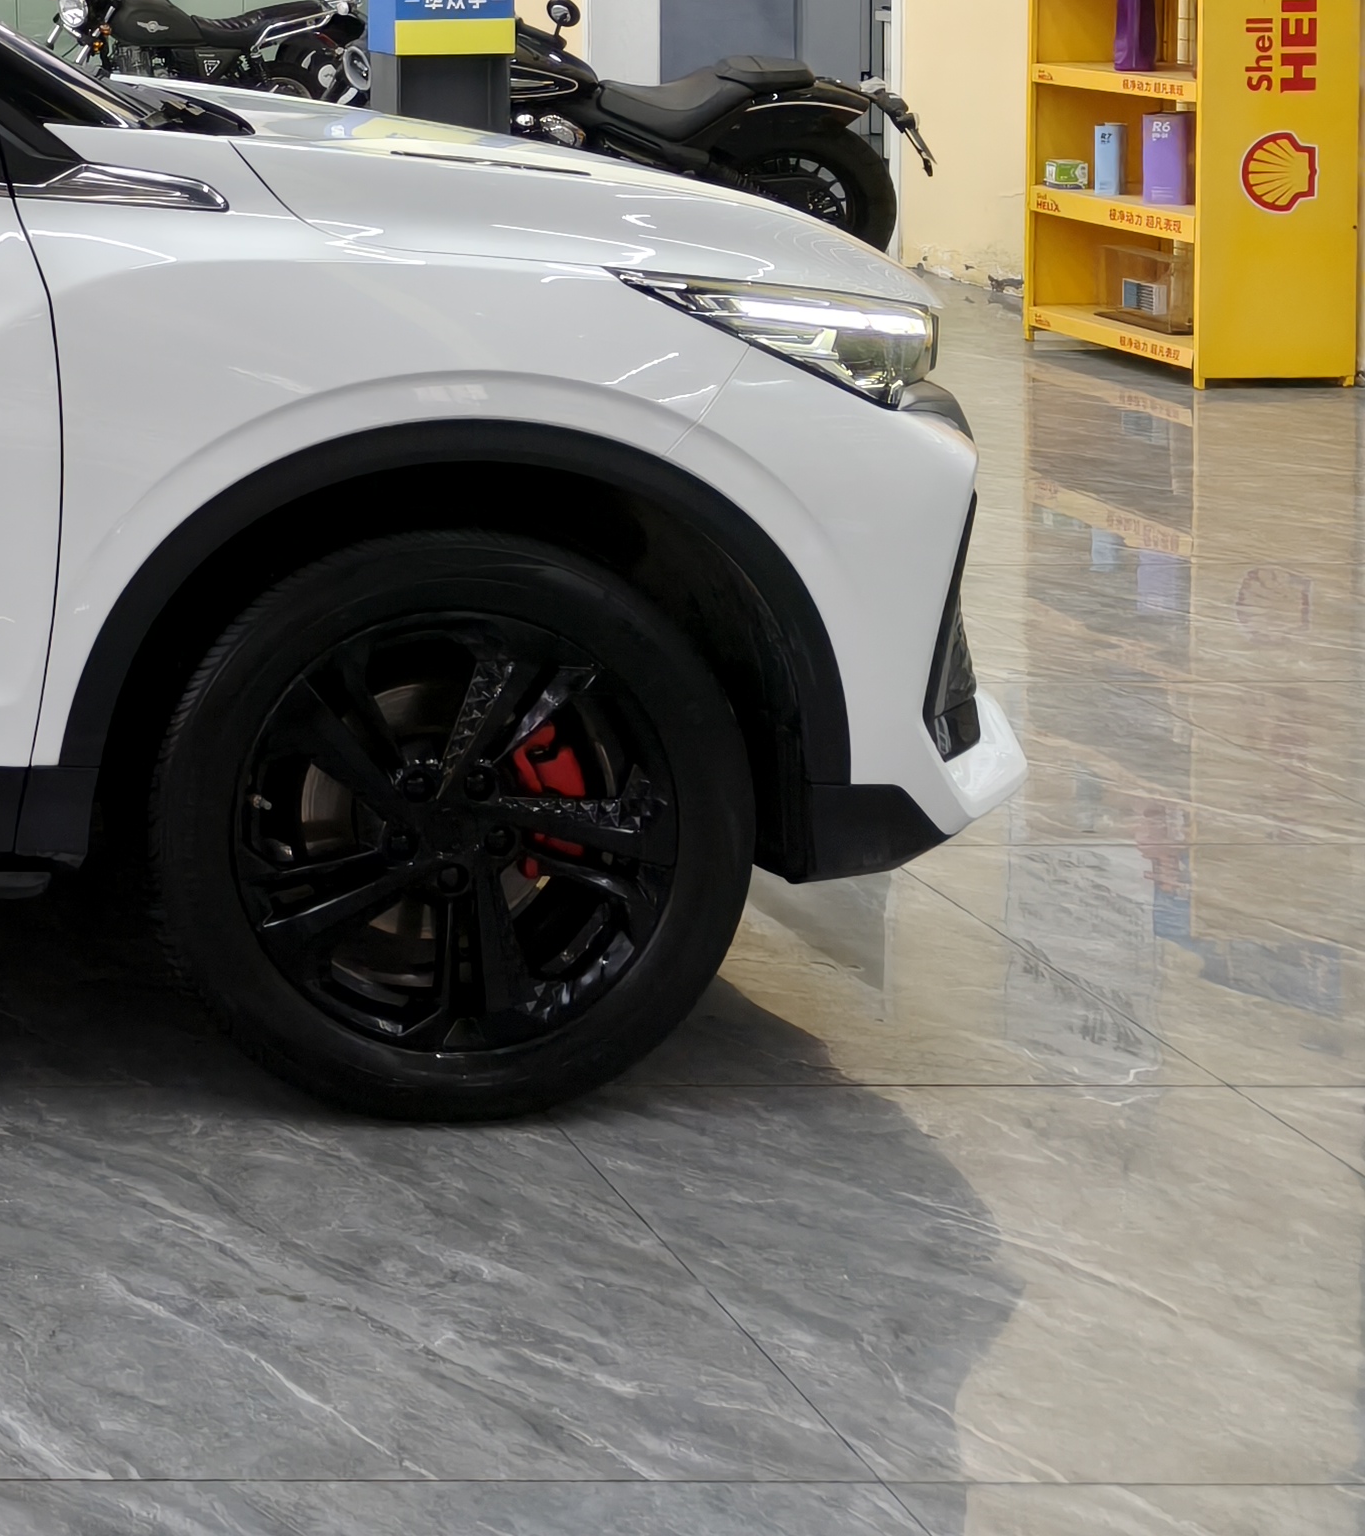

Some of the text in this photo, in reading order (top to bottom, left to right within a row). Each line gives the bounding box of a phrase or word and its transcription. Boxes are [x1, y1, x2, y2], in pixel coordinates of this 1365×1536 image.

[1245, 18, 1273, 92] Shell
[1152, 121, 1171, 133] R6
[1100, 132, 1113, 140] R7
[1036, 198, 1061, 213] HELIX
